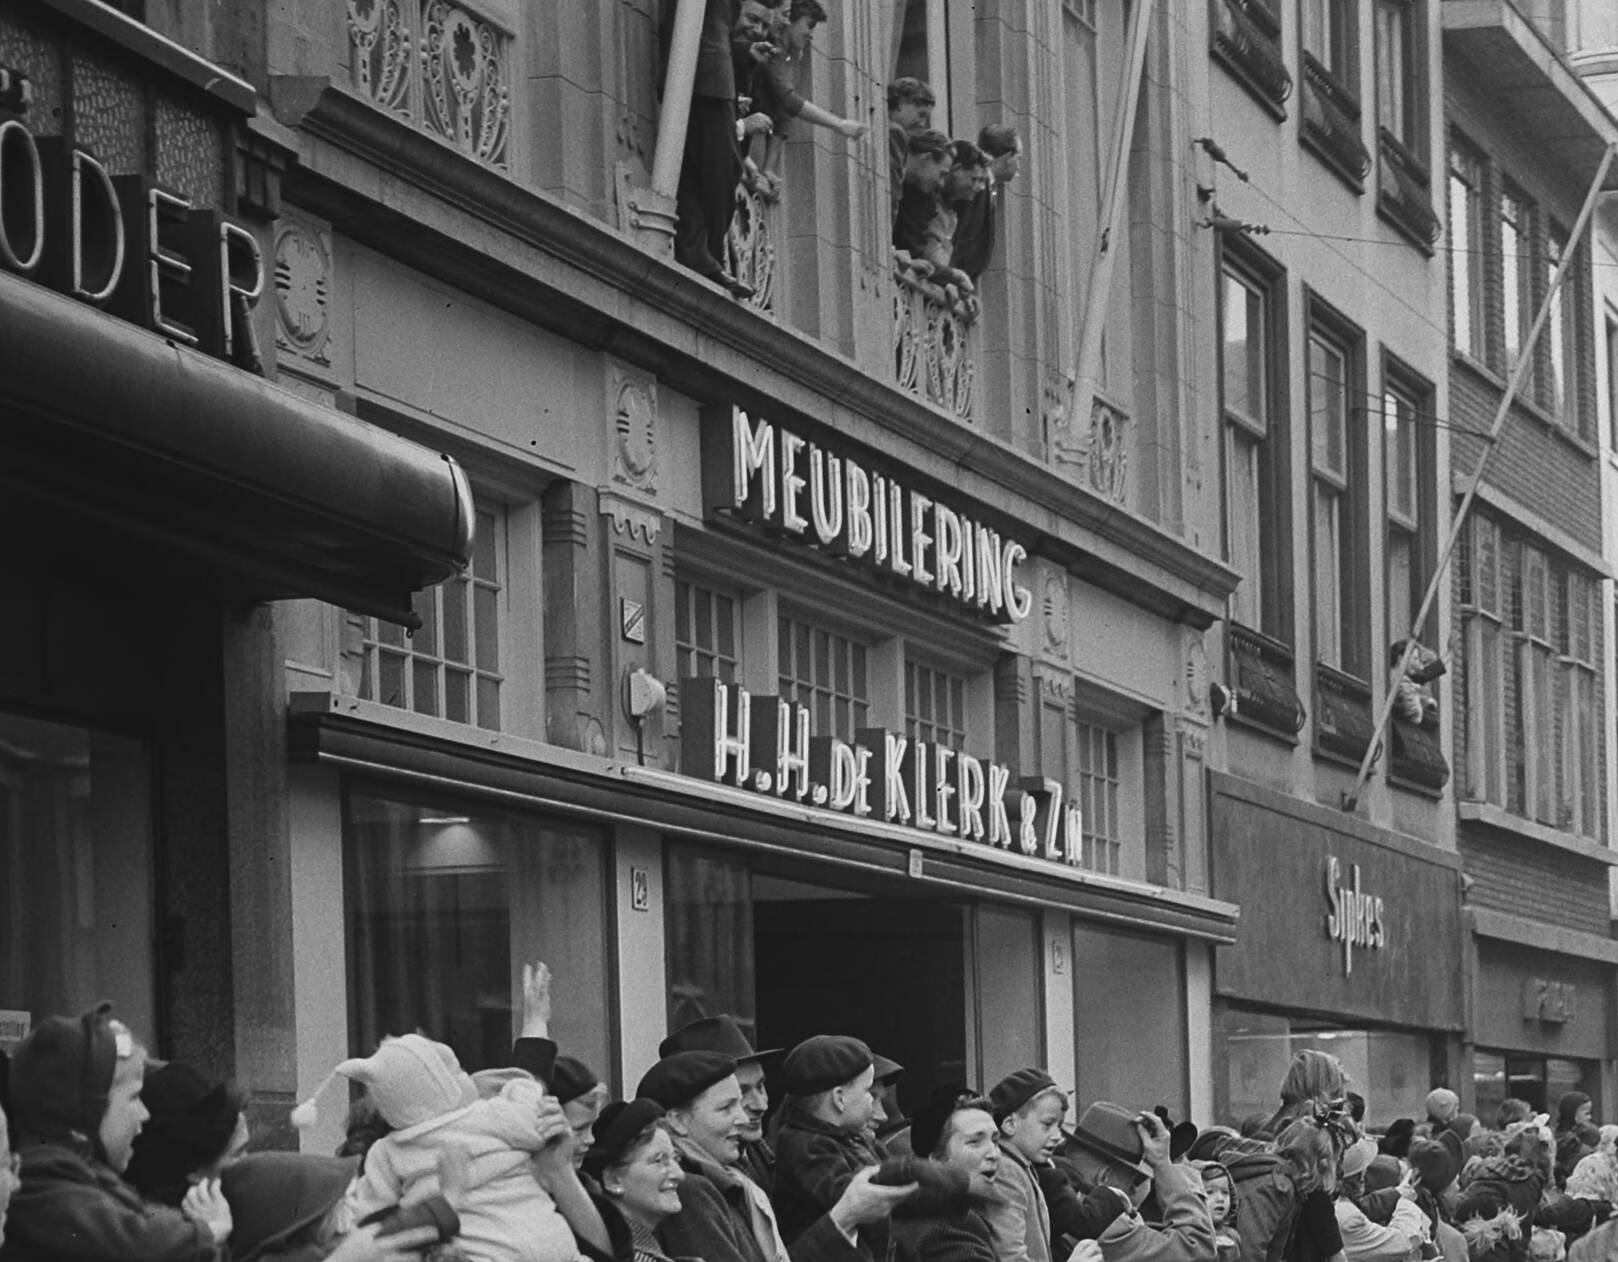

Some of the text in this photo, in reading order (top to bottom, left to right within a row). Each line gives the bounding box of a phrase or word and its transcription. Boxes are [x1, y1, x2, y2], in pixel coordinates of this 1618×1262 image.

[733, 404, 1031, 625] MEUBILERING
[885, 730, 1011, 848] KLERK
[1020, 791, 1037, 855] &
[1327, 855, 1384, 977] Sipkes
